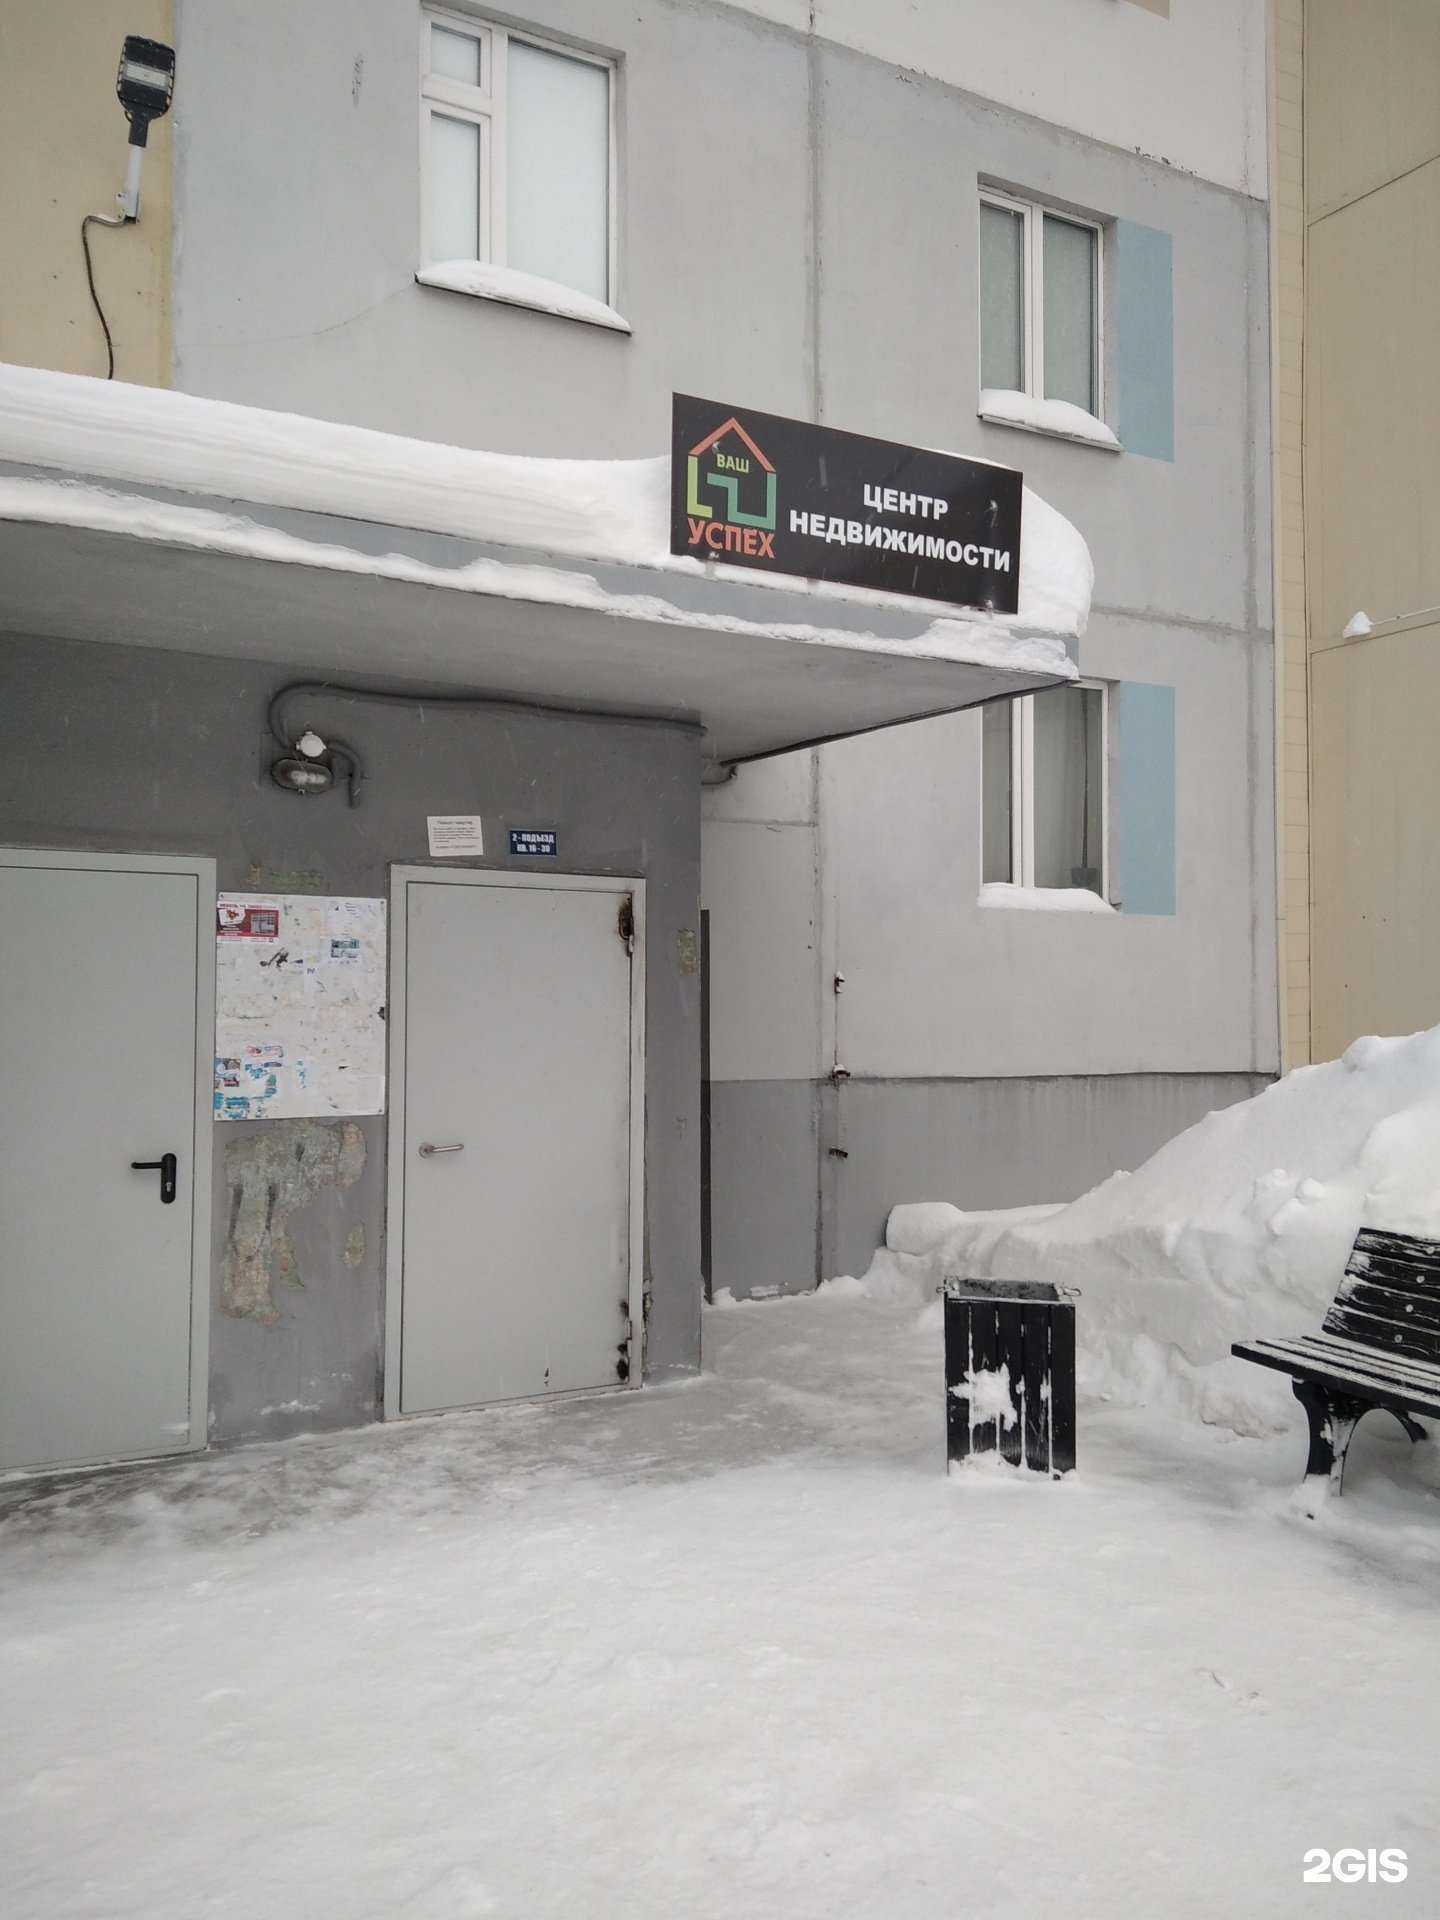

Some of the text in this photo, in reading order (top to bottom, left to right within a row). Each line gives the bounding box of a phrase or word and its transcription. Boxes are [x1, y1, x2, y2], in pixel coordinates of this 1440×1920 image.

[716, 453, 749, 473] ВАШ
[863, 483, 949, 521] ЦЕНТР
[687, 517, 776, 559] УСПЕХ
[790, 509, 1011, 573] НЕДВИЖИМОСТИ
